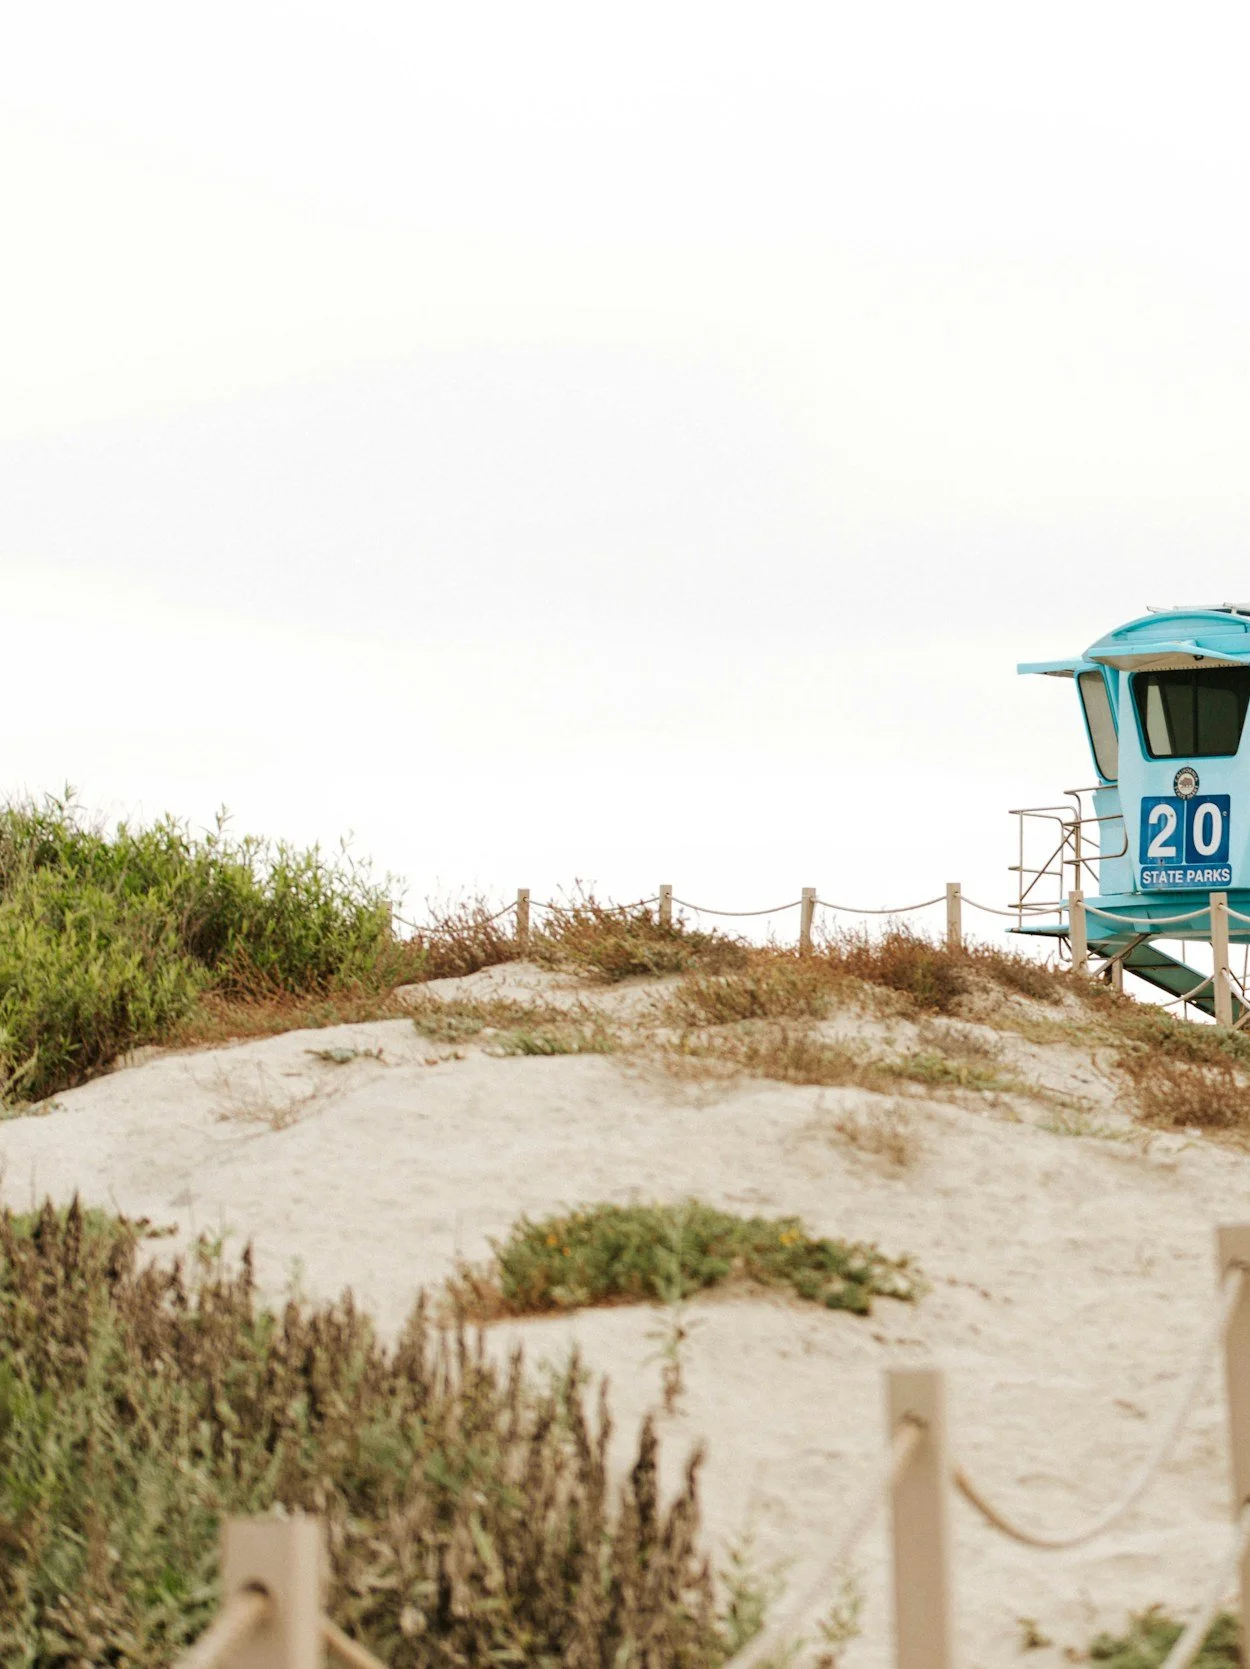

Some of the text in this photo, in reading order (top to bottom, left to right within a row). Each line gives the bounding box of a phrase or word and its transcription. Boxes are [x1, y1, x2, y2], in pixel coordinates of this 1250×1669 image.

[1148, 803, 1222, 856] 20
[1143, 869, 1230, 883] STATE PARKS
